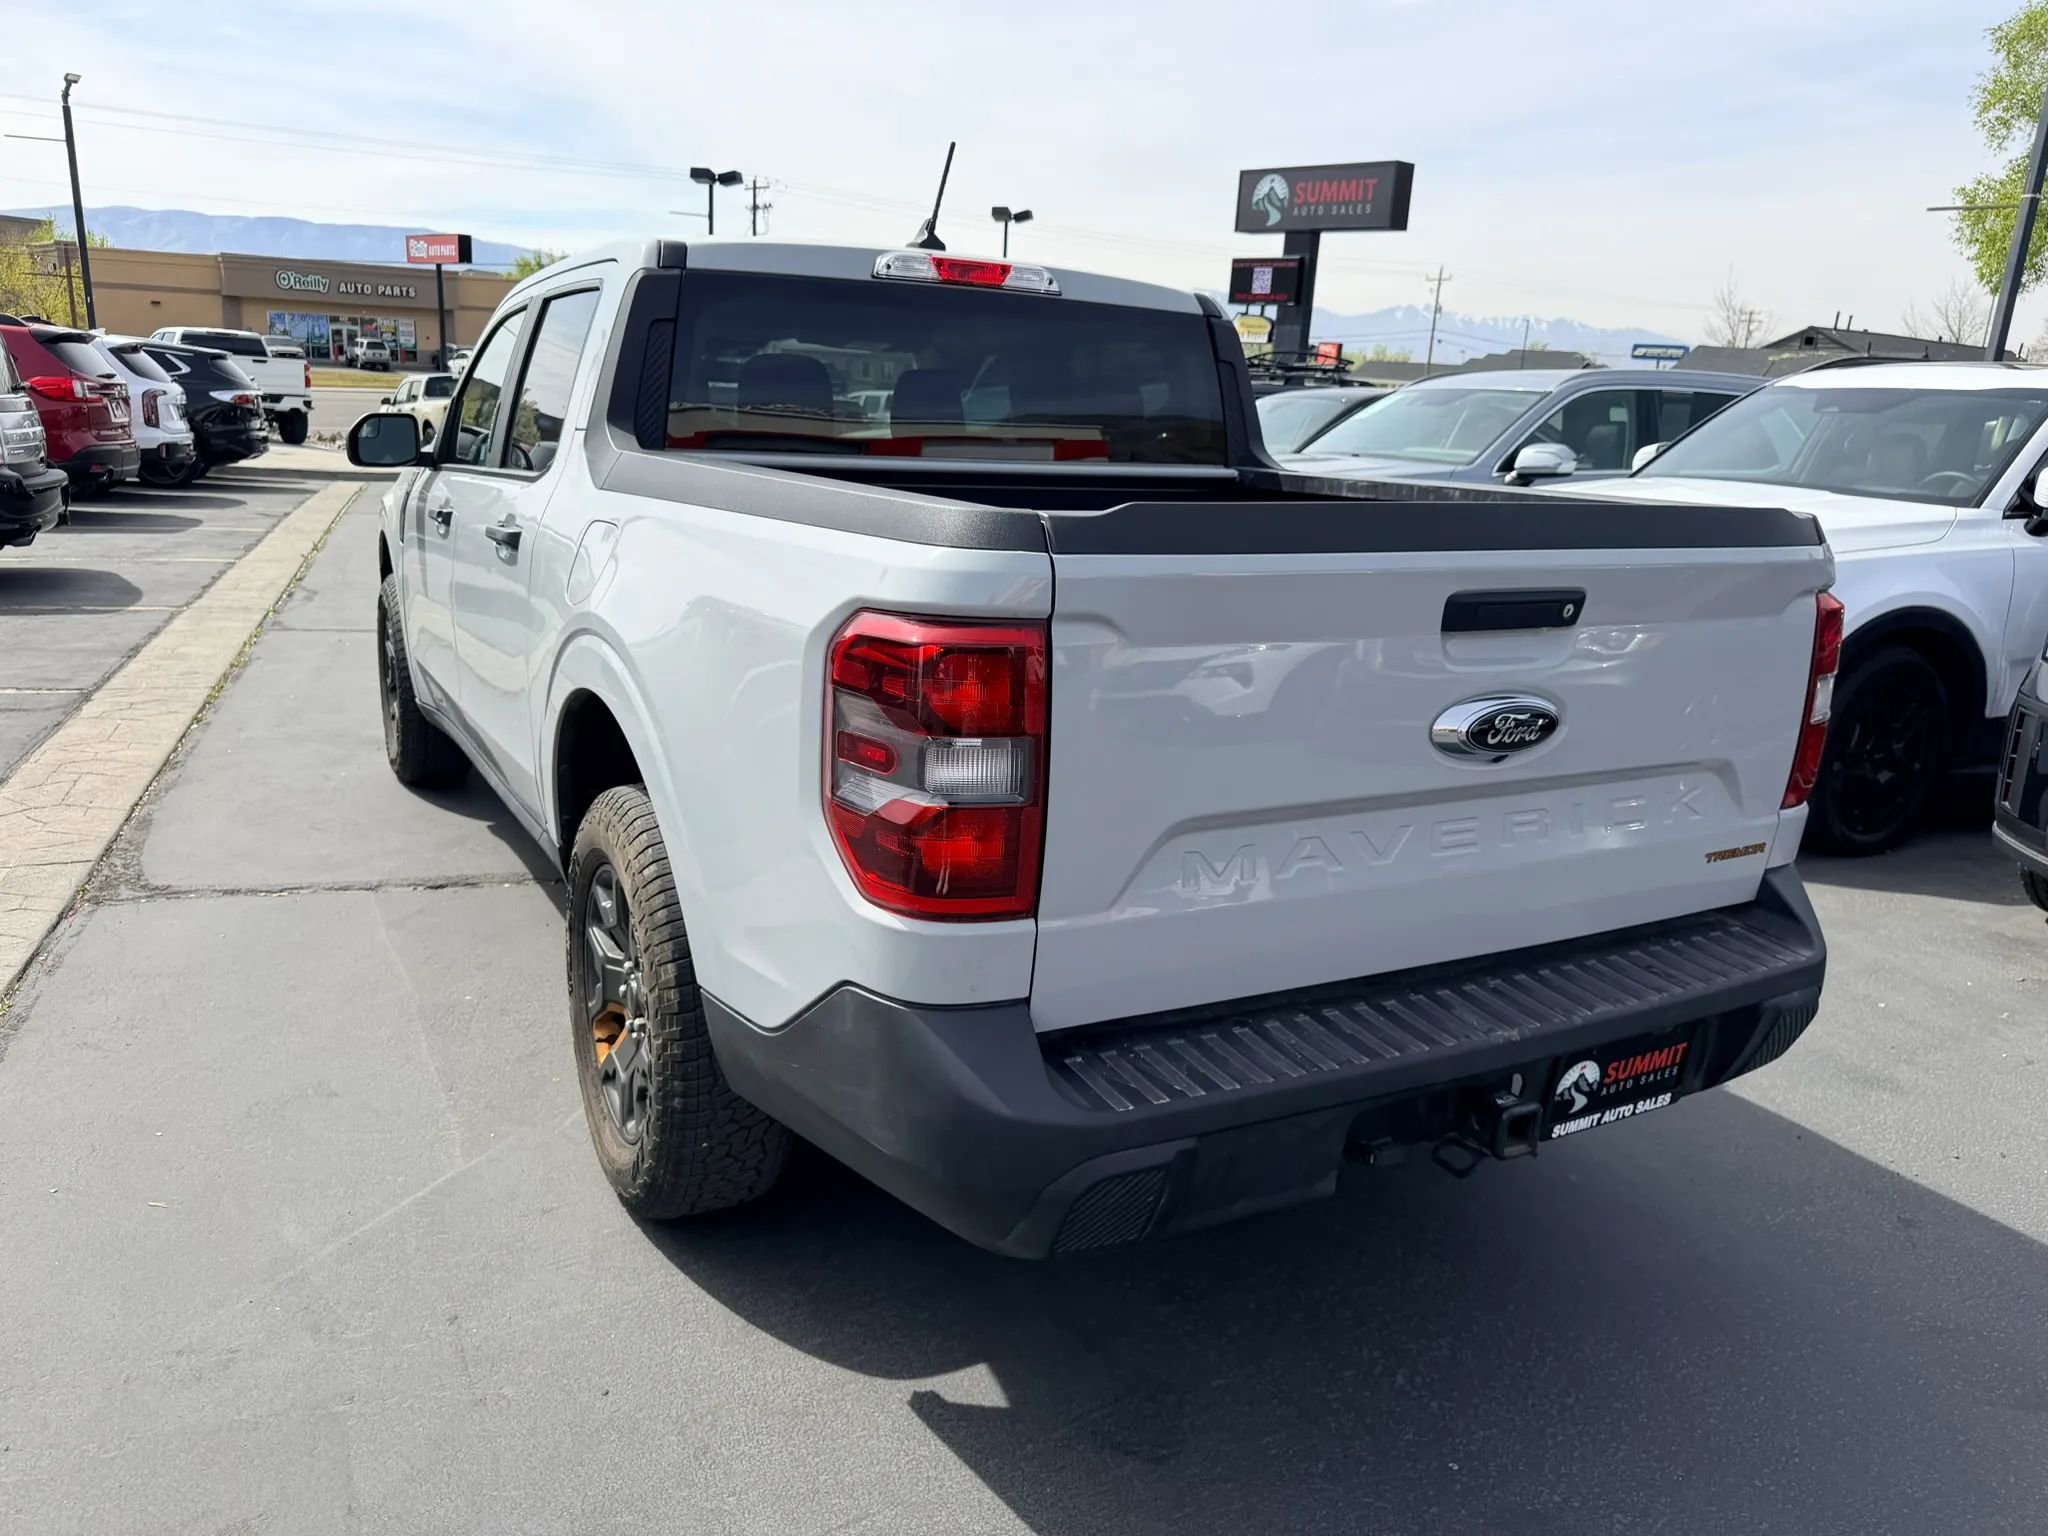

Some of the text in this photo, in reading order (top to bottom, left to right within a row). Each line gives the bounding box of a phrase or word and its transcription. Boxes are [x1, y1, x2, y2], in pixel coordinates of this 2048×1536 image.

[1295, 178, 1377, 204] SUMMIT
[1293, 204, 1371, 216] AUTO SALES
[428, 244, 440, 257] AUTO
[441, 244, 456, 257] PARTS
[276, 270, 416, 298] O'Reilly AUTO PARTS
[1487, 713, 1542, 745] Ford
[1180, 782, 1706, 892] MAVERICK
[1705, 842, 1767, 864] TREMOR
[1603, 1042, 1687, 1085] SUMMIT
[1601, 1066, 1679, 1096] AUTO SALES
[1551, 1093, 1672, 1138] SUMMIT AUTO SALES
